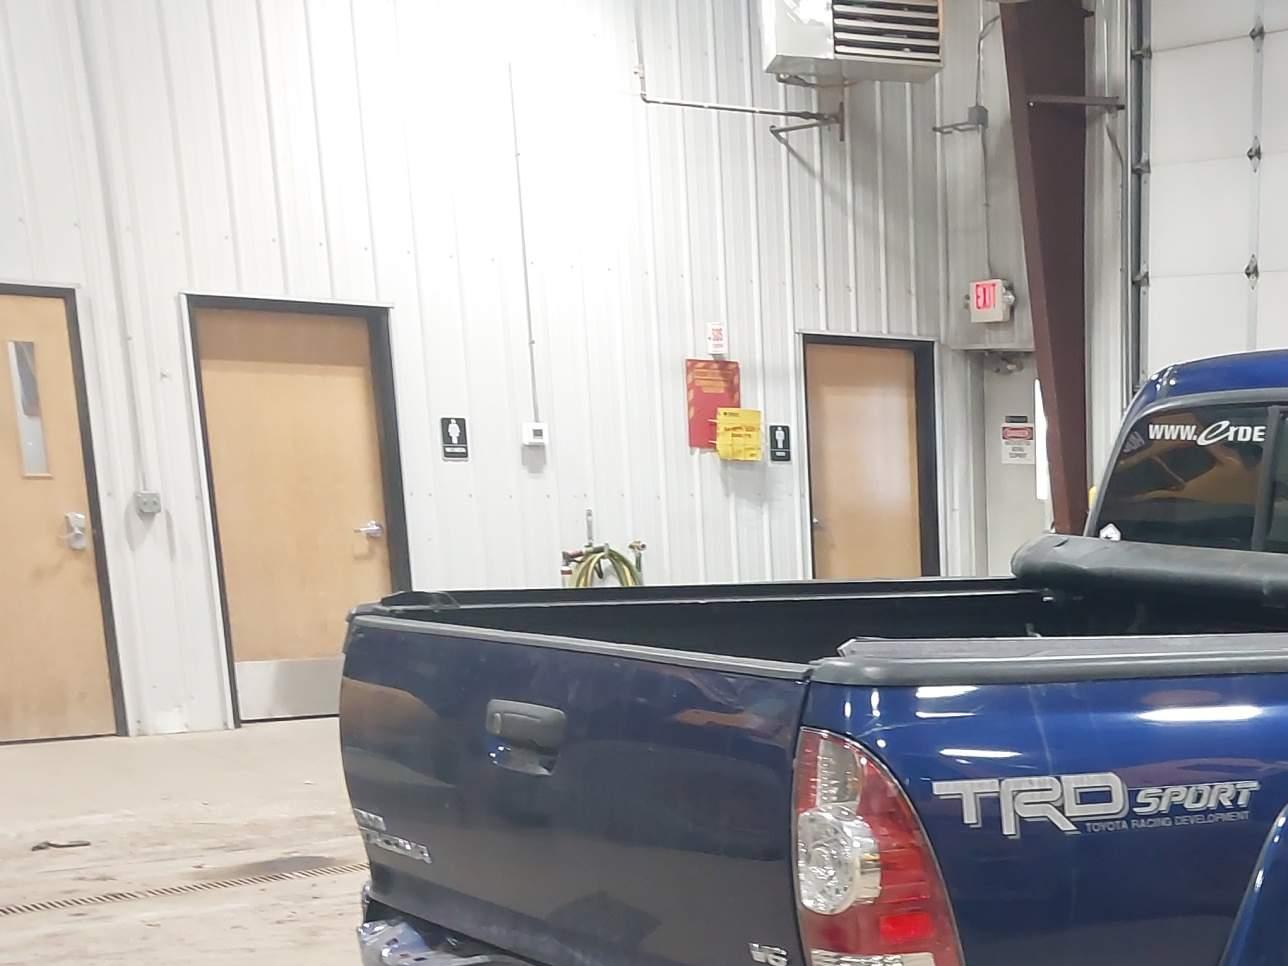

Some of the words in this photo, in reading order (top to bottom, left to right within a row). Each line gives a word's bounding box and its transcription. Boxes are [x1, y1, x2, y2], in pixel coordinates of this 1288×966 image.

[932, 772, 1129, 839] TRD
[1133, 780, 1260, 816] SPORT
[1086, 820, 1129, 833] TOYOTA
[1131, 816, 1173, 829] RACING
[1174, 811, 1249, 826] DEVELOPMENT
